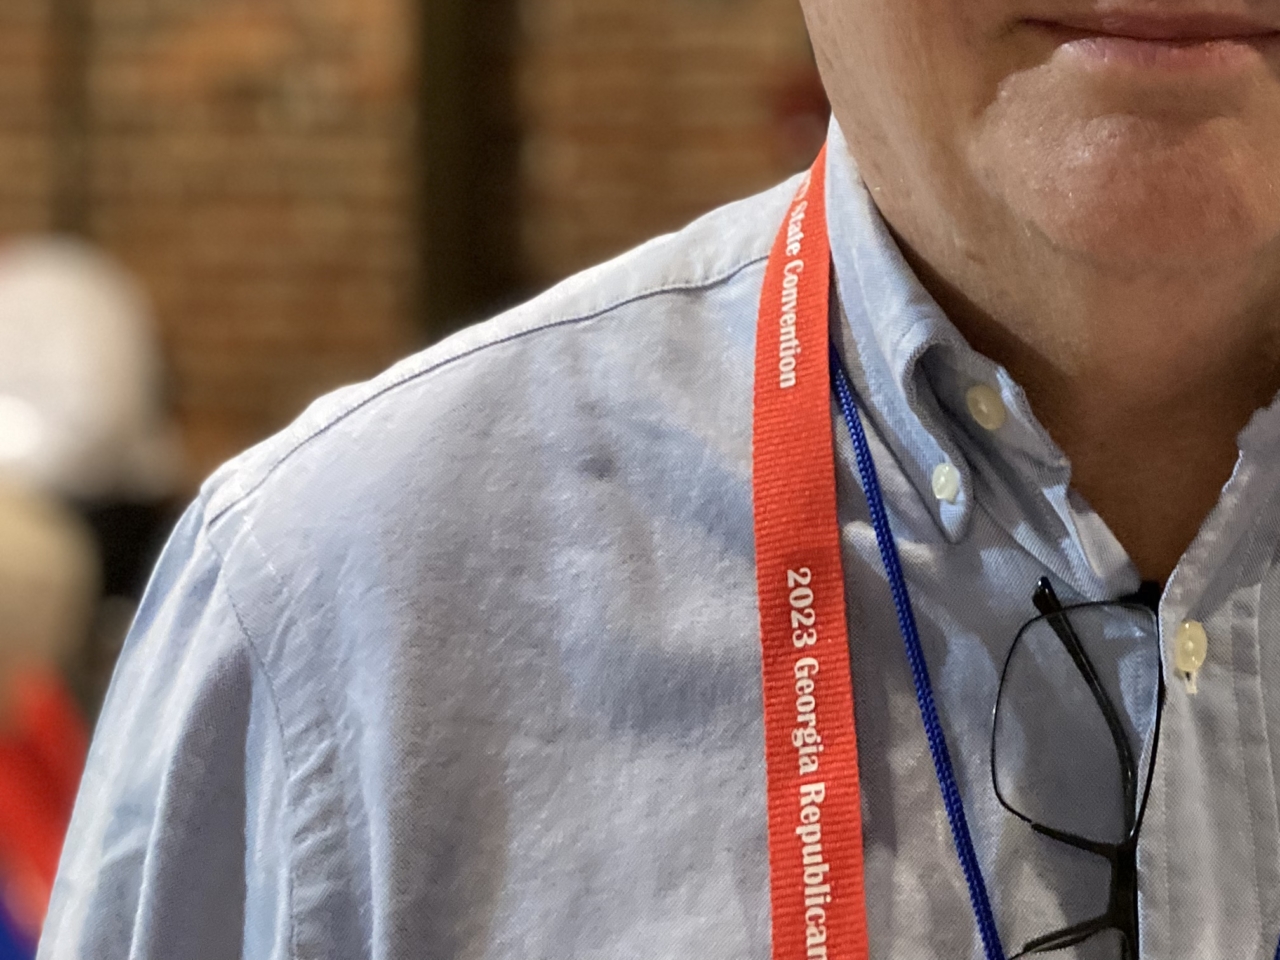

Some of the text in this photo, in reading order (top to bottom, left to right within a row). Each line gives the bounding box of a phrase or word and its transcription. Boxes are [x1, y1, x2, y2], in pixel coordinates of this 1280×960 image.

[785, 200, 808, 257] State
[779, 259, 803, 388] Convention
[786, 567, 832, 960] 2023 Georgia Republican
